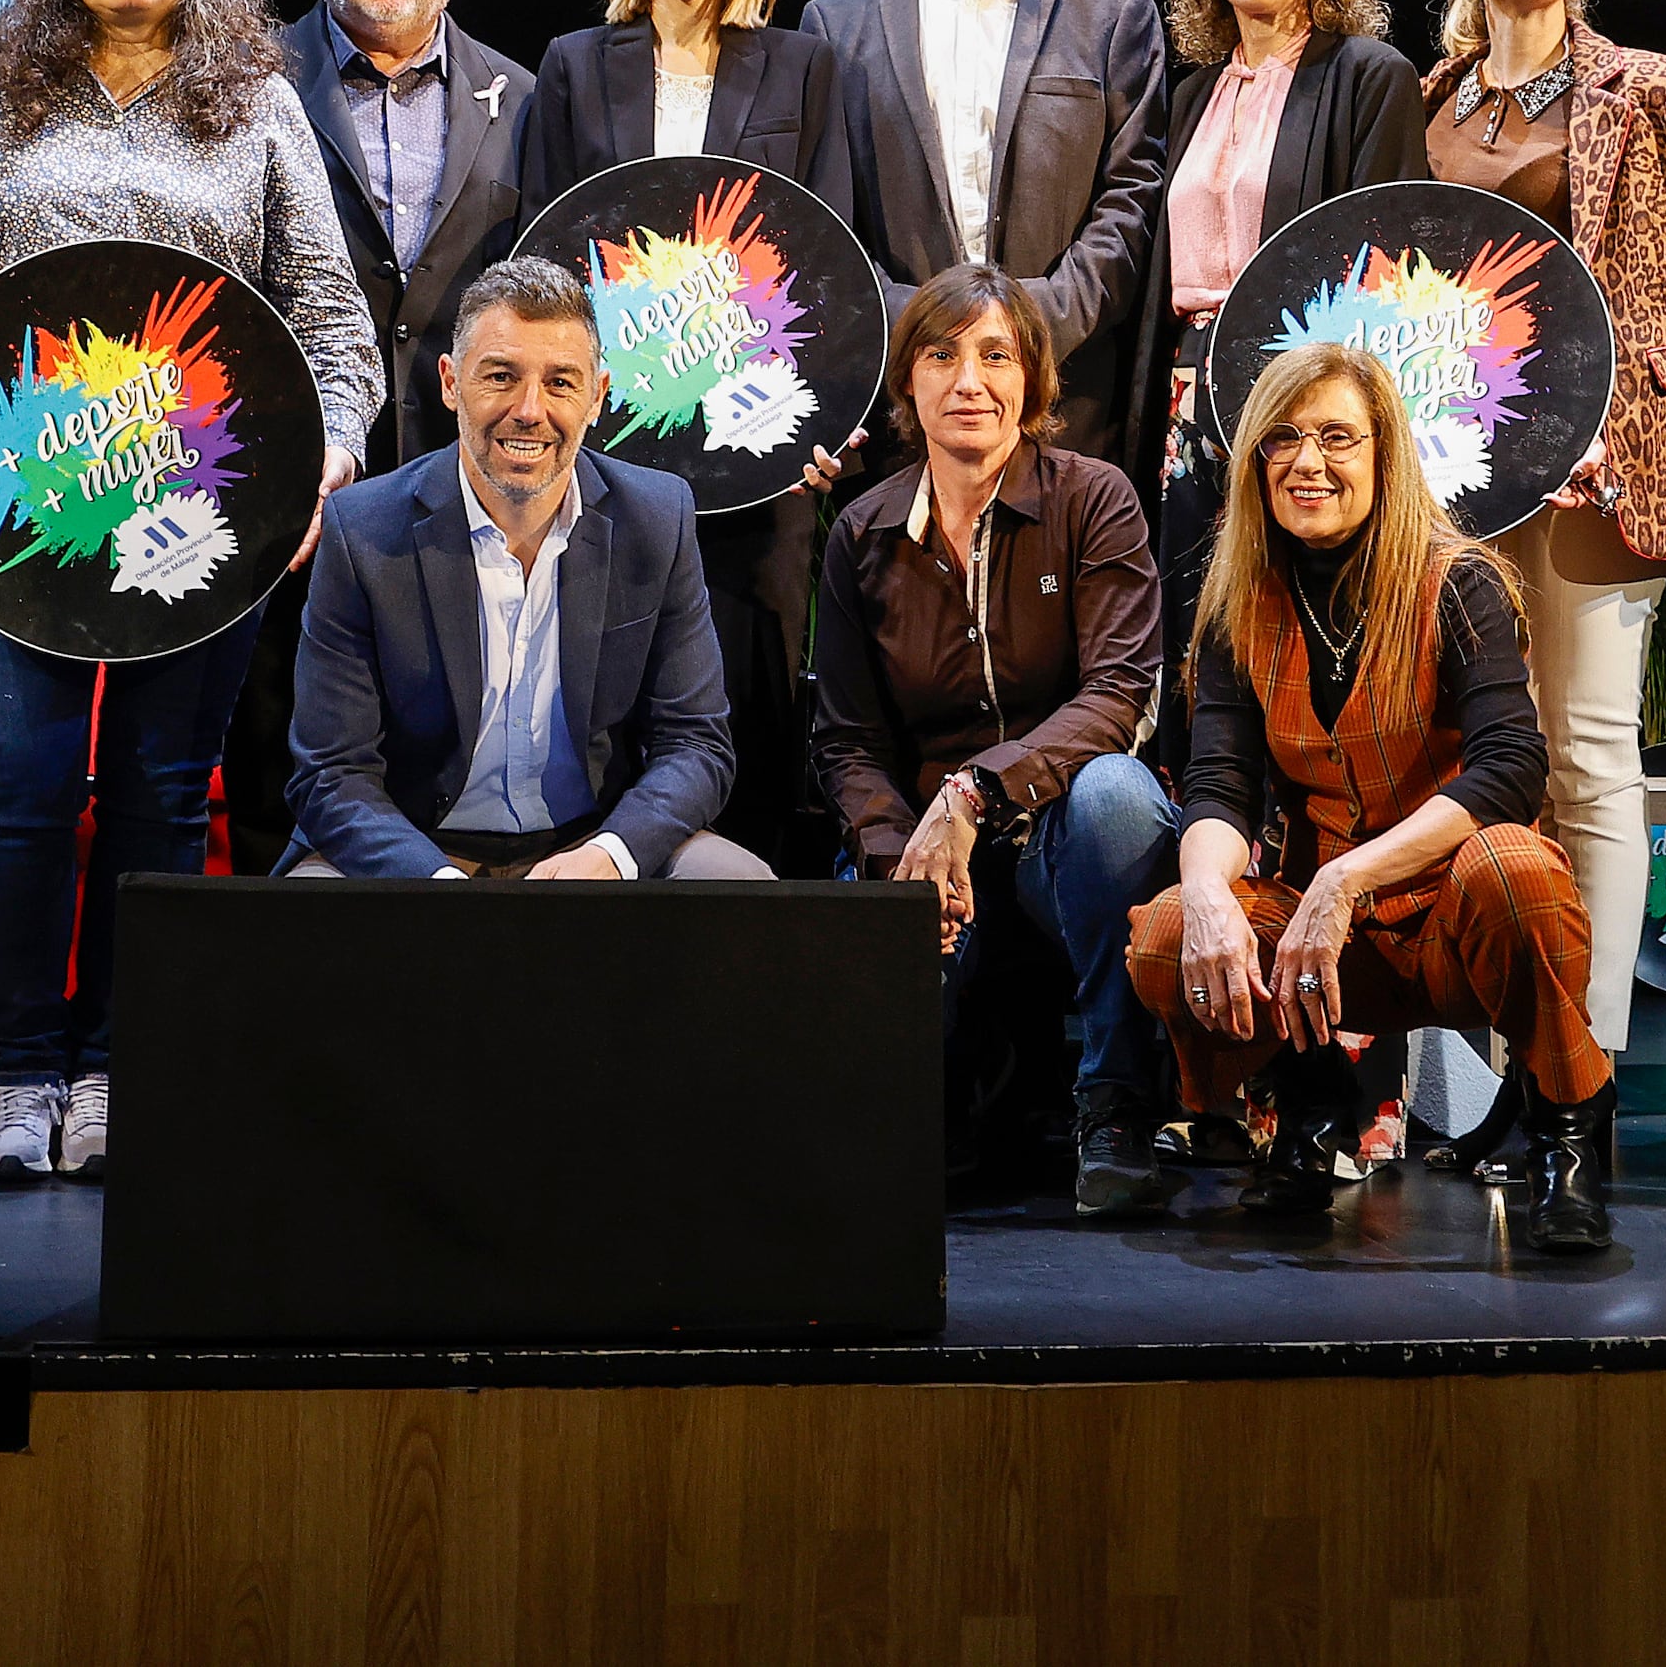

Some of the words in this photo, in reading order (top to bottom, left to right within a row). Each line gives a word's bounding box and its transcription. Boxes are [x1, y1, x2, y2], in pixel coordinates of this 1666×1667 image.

[617, 250, 741, 352] deporte
[660, 303, 771, 380] mujer
[37, 359, 184, 461] deporte
[77, 420, 201, 504] mujer
